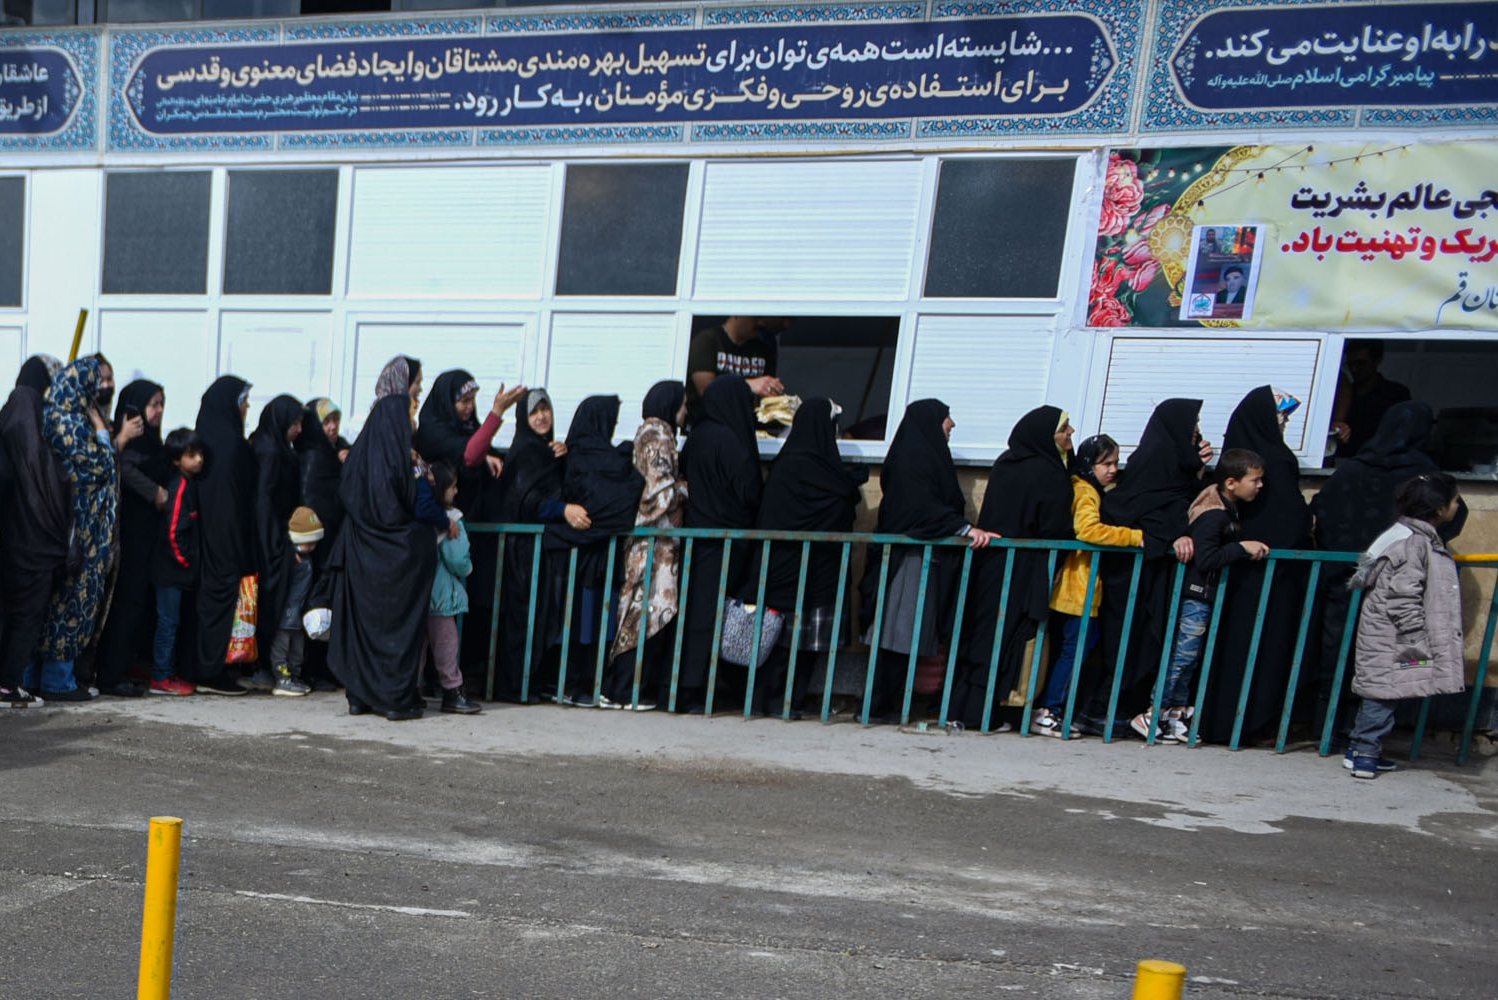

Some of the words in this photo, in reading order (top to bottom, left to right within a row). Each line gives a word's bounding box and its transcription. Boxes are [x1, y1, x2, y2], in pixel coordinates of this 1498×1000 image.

[706, 39, 756, 73] برای
[755, 38, 809, 71] توان
[881, 33, 945, 61] است
[1313, 24, 1404, 62] عنایت
[1402, 23, 1432, 61] او
[1431, 29, 1462, 61] به
[1463, 22, 1487, 60] را
[156, 56, 221, 90] قدسی
[231, 59, 297, 88] معنوی
[296, 50, 358, 85] فضای
[357, 50, 414, 83] ایجاد
[425, 46, 518, 79] مشتاقان
[625, 42, 708, 76] تسهیل
[1339, 63, 1392, 88] گرامی
[683, 75, 768, 111] فکری
[1000, 69, 1070, 103] برای
[1228, 75, 1250, 89] علیه
[1266, 73, 1293, 88] صلی
[1290, 66, 1342, 90] اسلام
[1388, 65, 1435, 88] پیامبر
[550, 88, 584, 114] به
[781, 83, 867, 109] روحی
[1290, 180, 1388, 219] بشریت
[1386, 182, 1453, 219] عالم
[1335, 226, 1421, 261] تهنیت
[1419, 235, 1437, 261] و
[1434, 271, 1469, 326] قم
